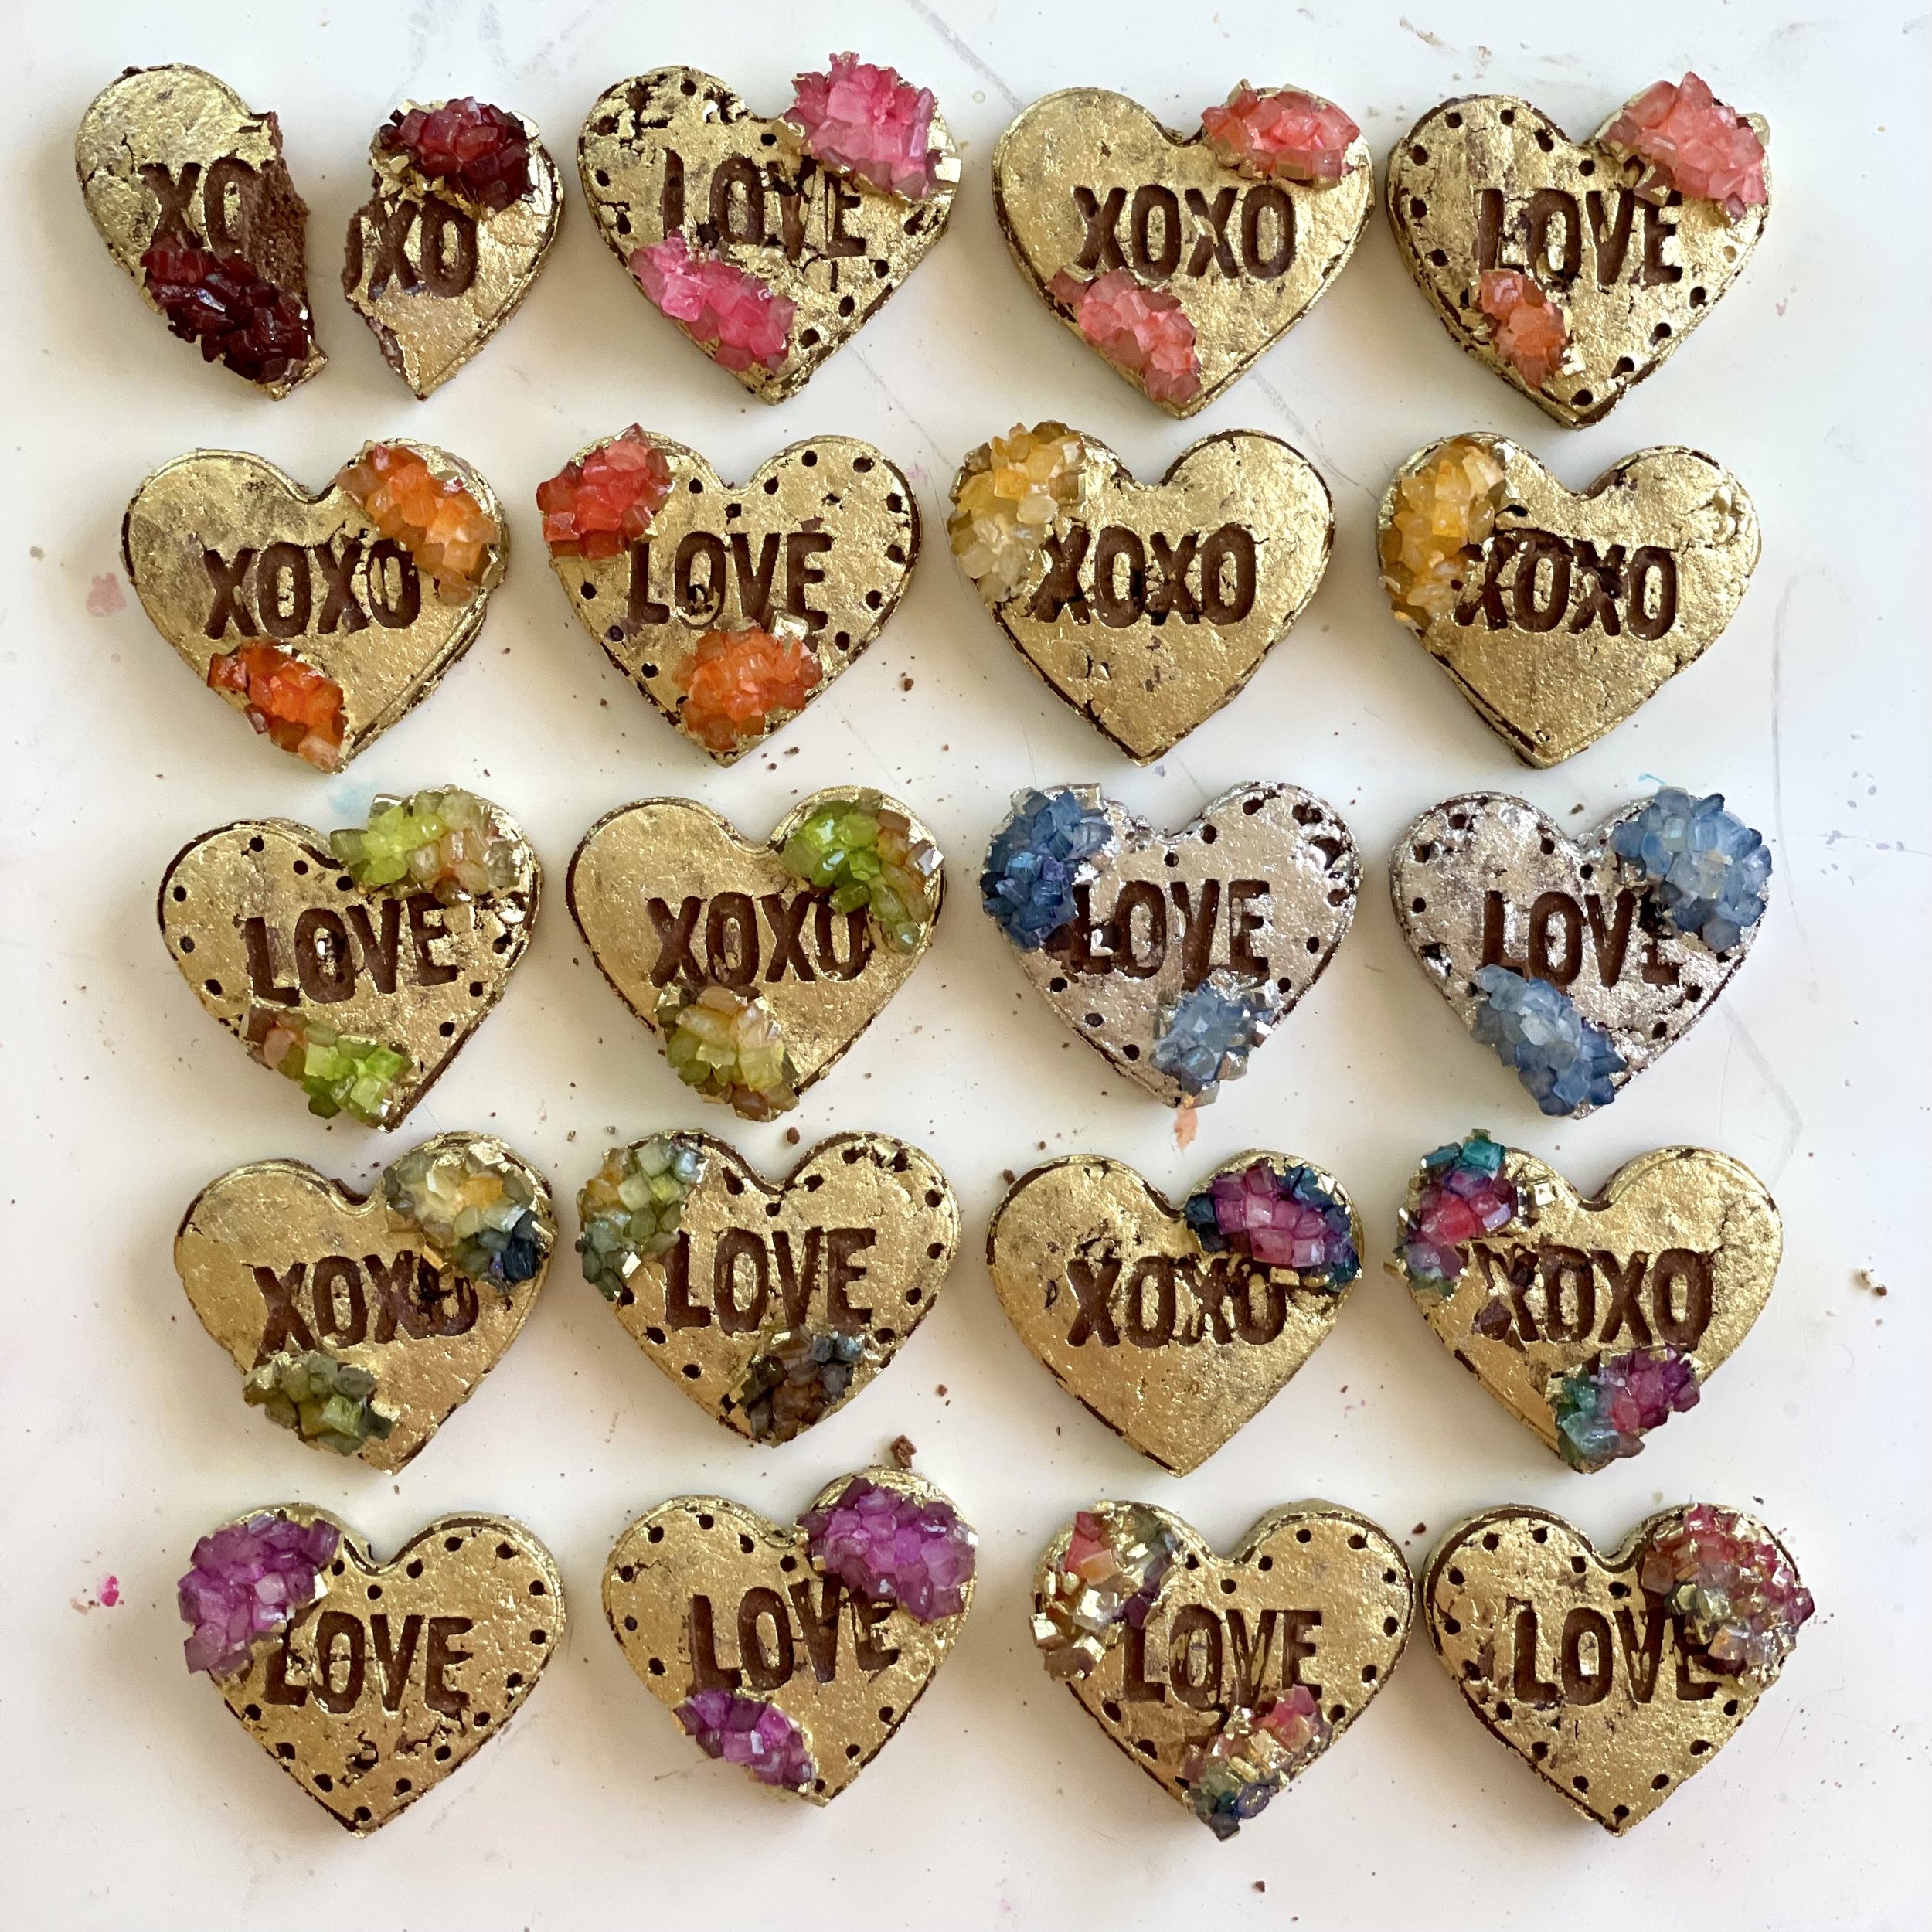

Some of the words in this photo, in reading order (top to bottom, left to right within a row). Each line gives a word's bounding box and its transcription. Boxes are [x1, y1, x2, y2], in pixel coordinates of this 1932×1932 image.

[139, 156, 259, 257] XO
[1071, 184, 1297, 281] XOXO
[1478, 187, 1683, 287] LOVE
[203, 538, 420, 639] XOXO
[628, 532, 833, 631] LOVE
[1030, 522, 1257, 628] XOXO
[1454, 527, 1677, 641] XOXO
[235, 893, 458, 1006] LOVE
[647, 890, 875, 989] XOXO
[1072, 879, 1270, 991] LOVE
[242, 1250, 479, 1365] XOXO
[665, 1226, 876, 1335] LOVE
[1066, 1253, 1287, 1348] XOXO
[1471, 1244, 1713, 1351] XOXO
[266, 1611, 473, 1715] LOVE
[688, 1574, 901, 1695] LOVE
[1124, 1604, 1322, 1709] LOVE
[1509, 1599, 1720, 1705] LOVE
